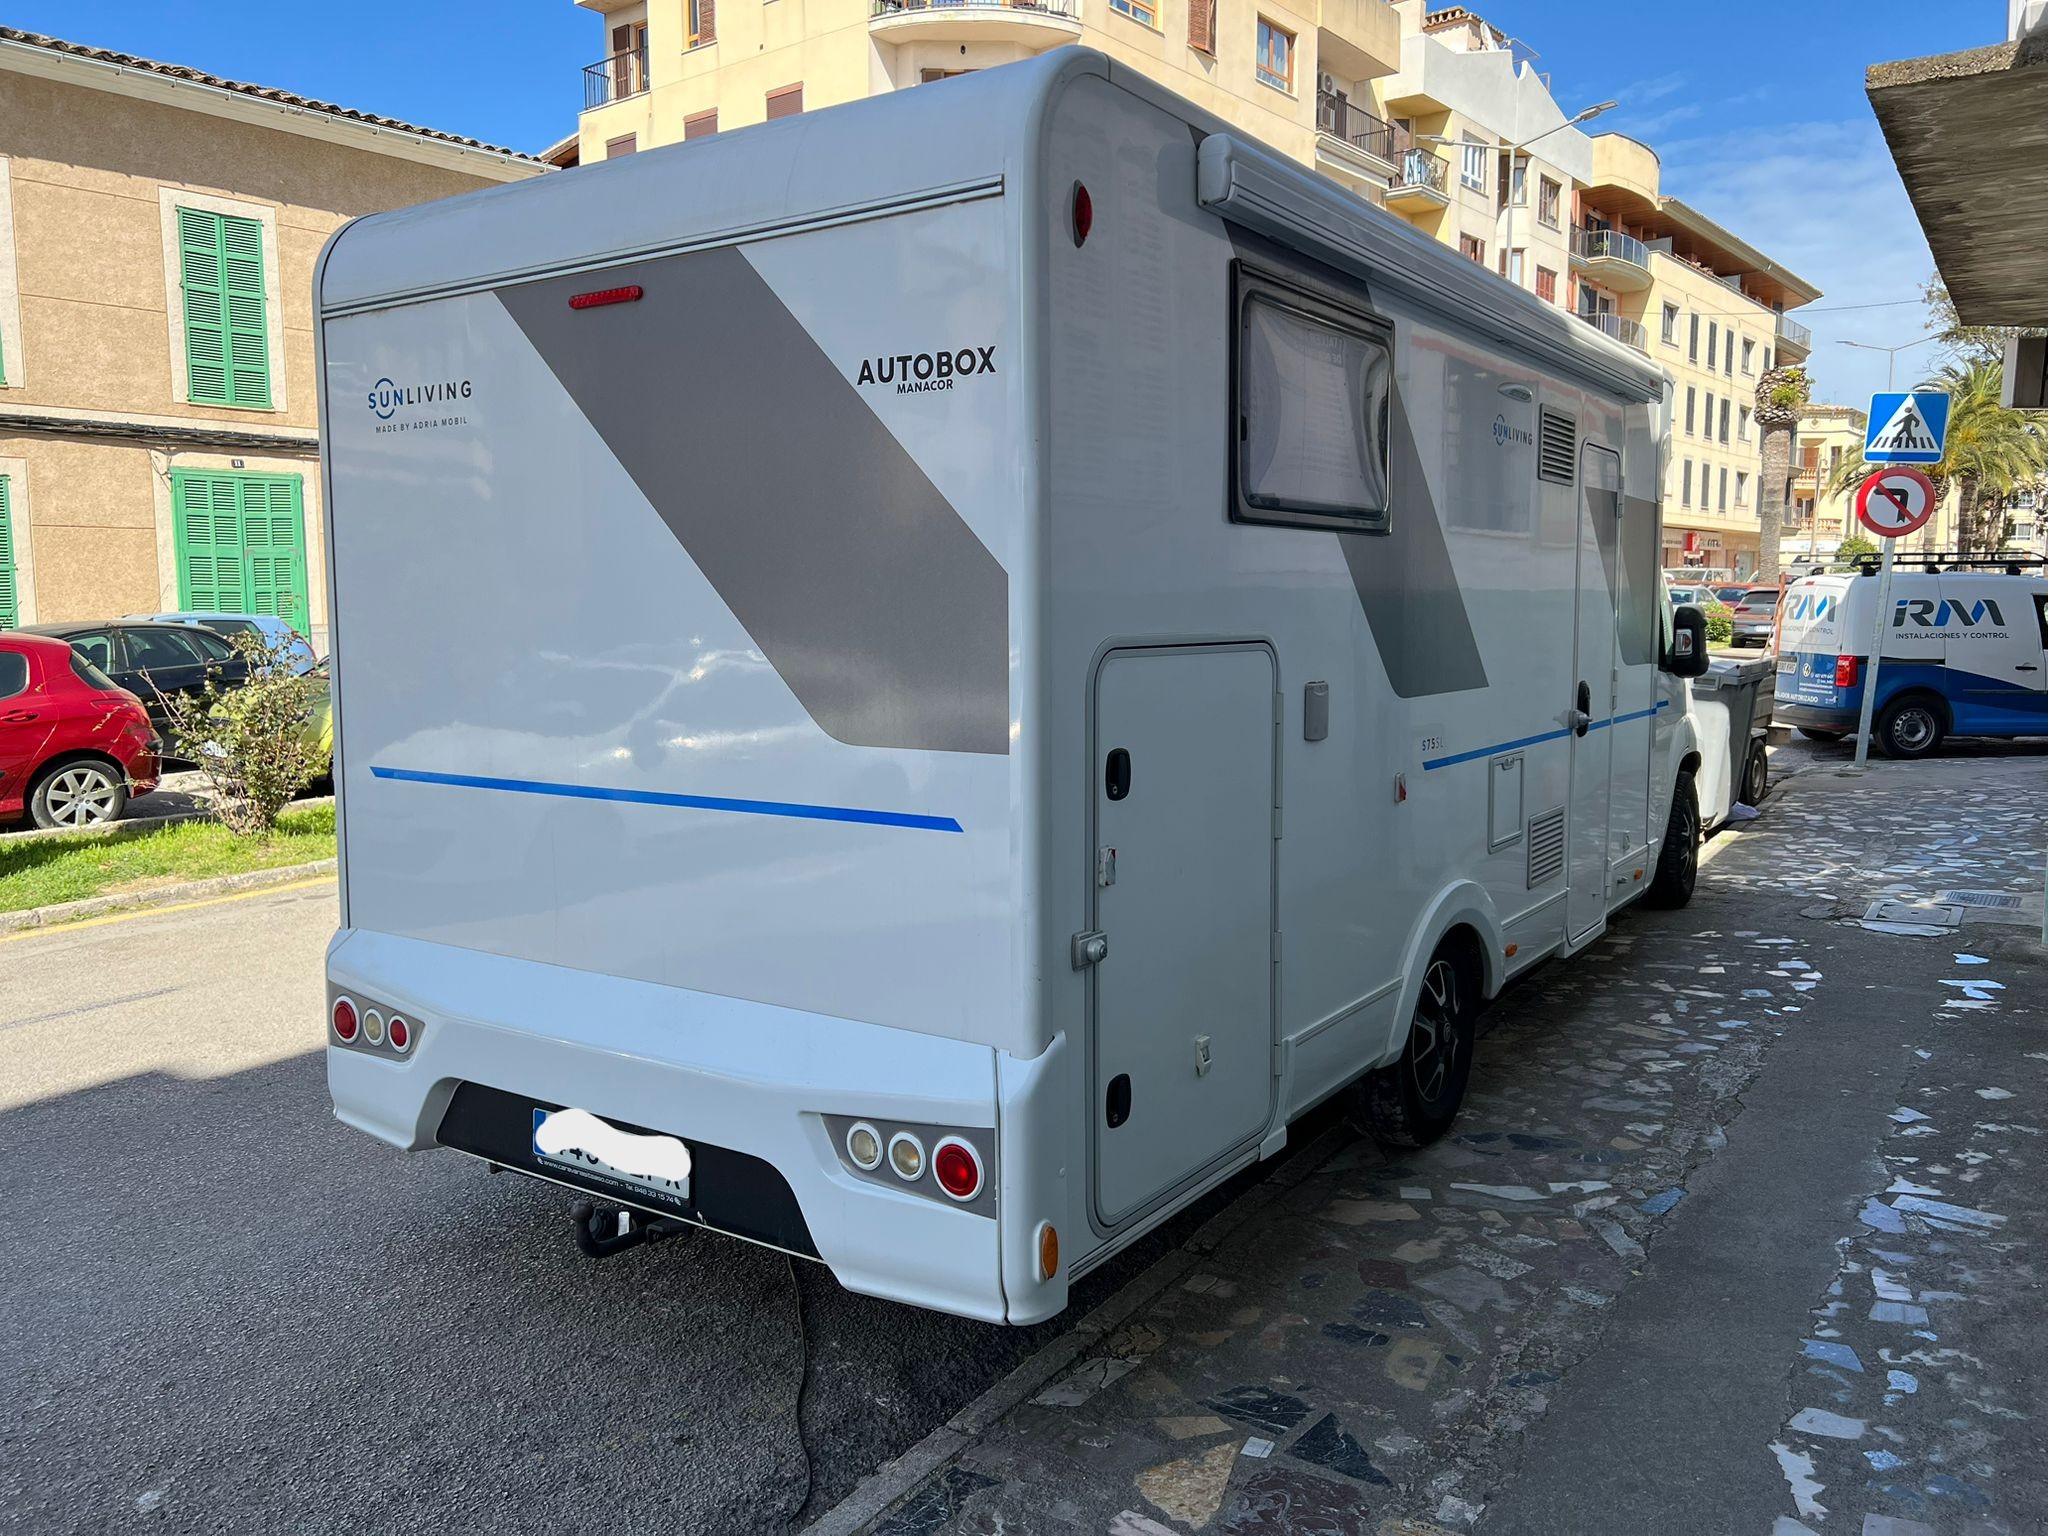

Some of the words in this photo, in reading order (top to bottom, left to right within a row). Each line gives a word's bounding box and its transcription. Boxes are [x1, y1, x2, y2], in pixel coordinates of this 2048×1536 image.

[857, 345, 997, 386] AUTOBOX
[368, 380, 472, 410] SUNLIVING
[896, 379, 954, 394] MANACOR
[375, 424, 397, 434] MADE
[400, 422, 410, 432] BY
[413, 420, 438, 430] ADRIA
[441, 416, 468, 426] MOBIL
[1493, 421, 1533, 446] SUNLIVING
[1895, 632, 1961, 640] INSTALACIONES
